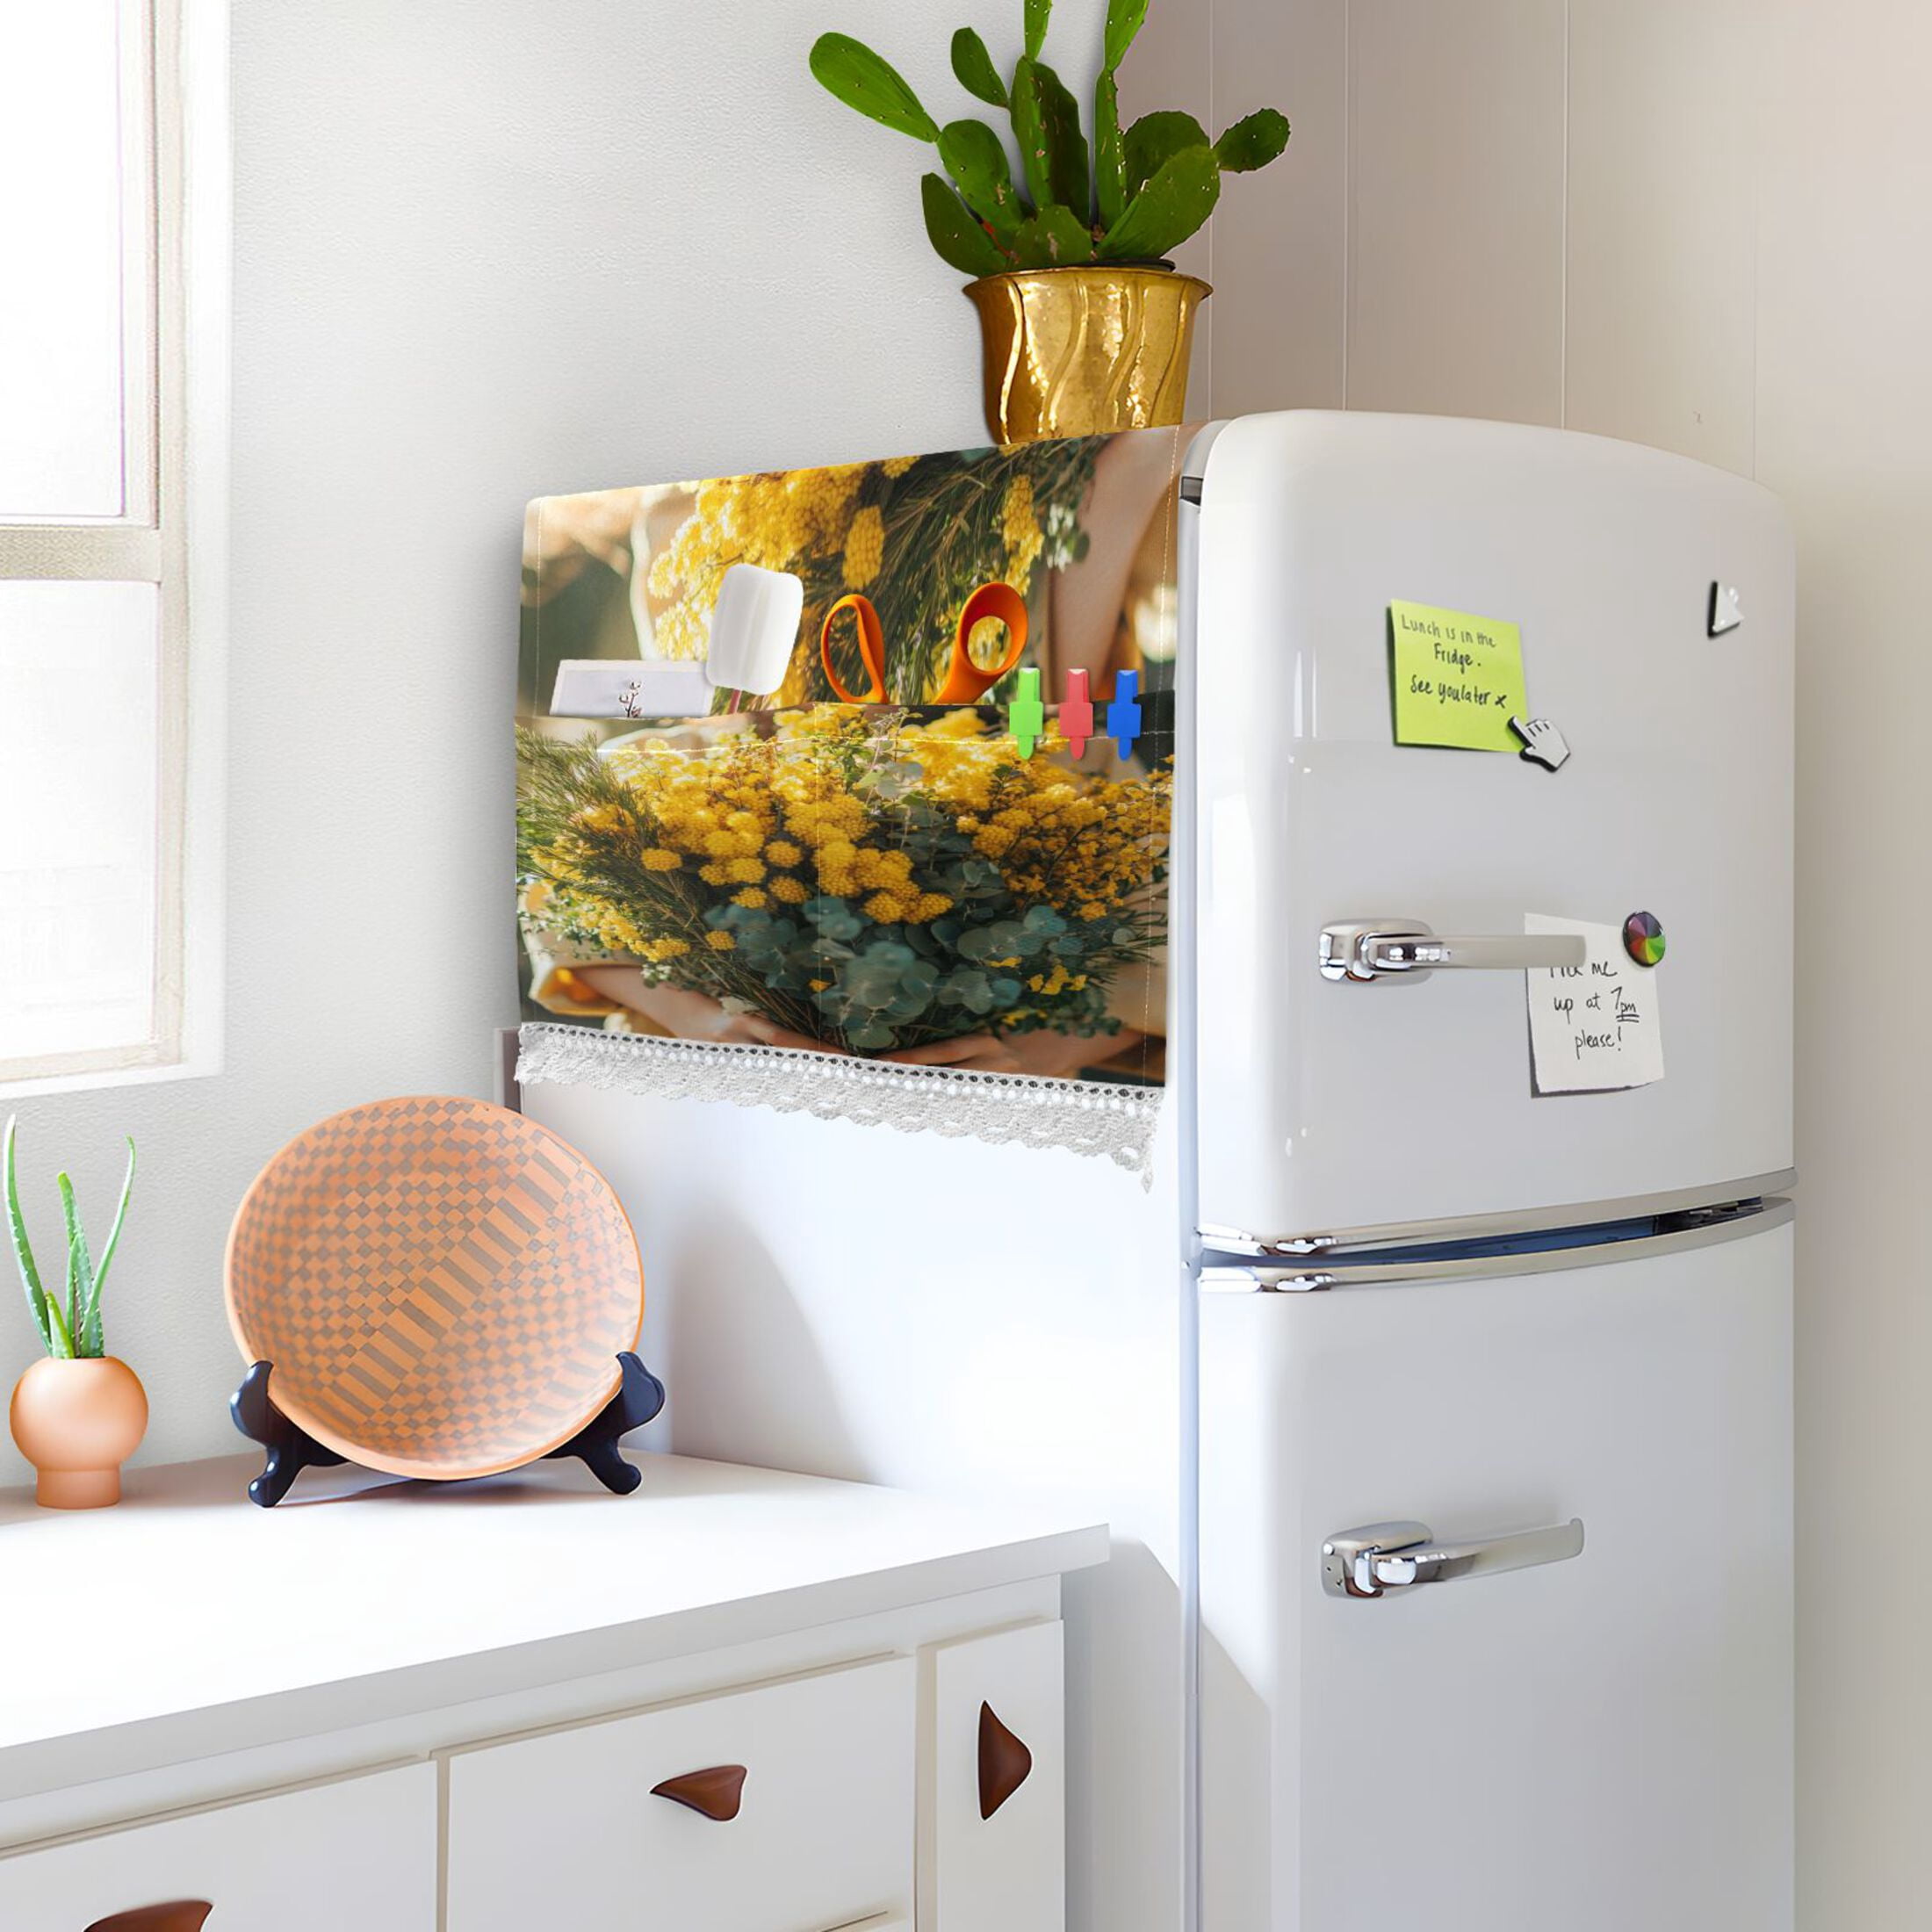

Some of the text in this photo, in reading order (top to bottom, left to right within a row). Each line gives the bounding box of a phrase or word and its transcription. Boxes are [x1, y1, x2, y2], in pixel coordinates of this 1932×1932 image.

[1401, 613, 1496, 648] Lunch is in the
[1410, 674, 1433, 694] See
[1591, 961, 1618, 977] me
[1553, 997, 1574, 1025] up
[1585, 991, 1601, 1011] at
[1575, 1026, 1622, 1061] please!
